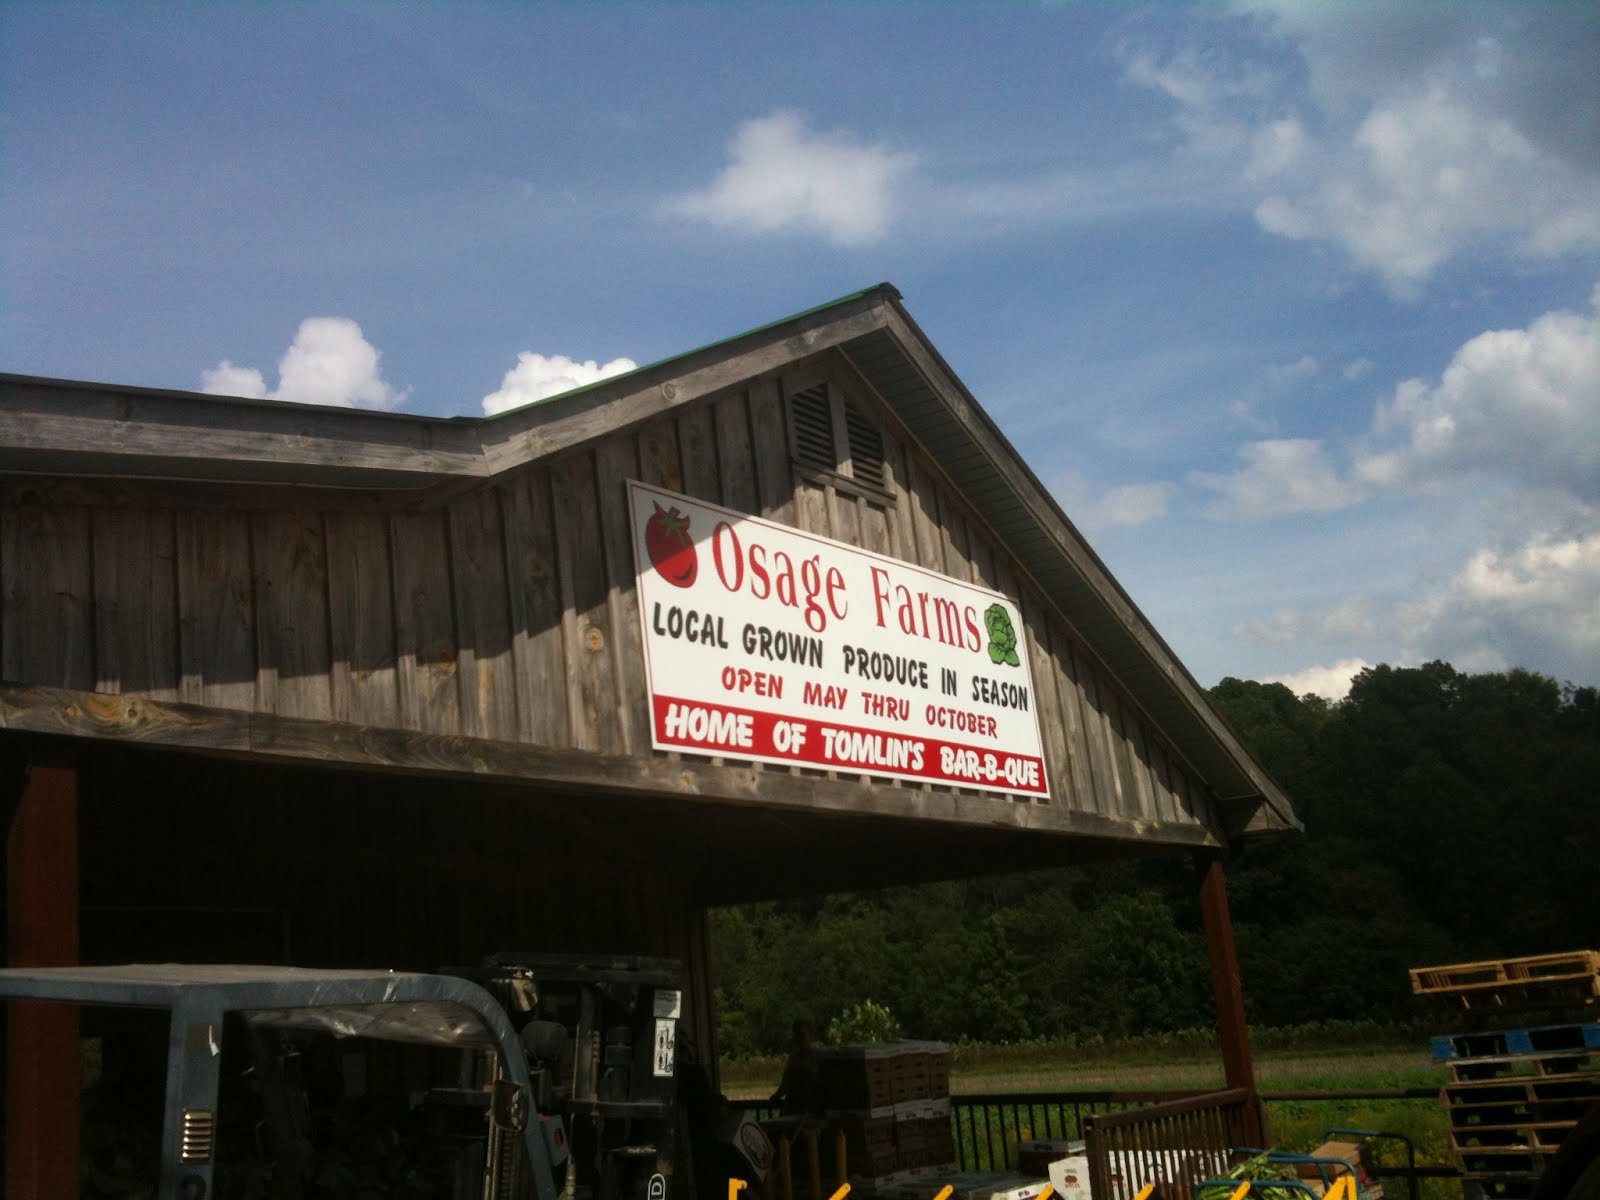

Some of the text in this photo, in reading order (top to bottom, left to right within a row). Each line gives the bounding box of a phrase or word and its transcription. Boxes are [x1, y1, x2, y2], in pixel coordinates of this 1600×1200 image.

[712, 521, 982, 653] Osage Farms
[653, 601, 1028, 712] LOCAL GROWN PRODUCE IN SEASON
[722, 666, 998, 739] OPEN MAY THRU OCTOBER
[665, 703, 1040, 788] HOME OF TOMLIN'S BAR-B-QUE
